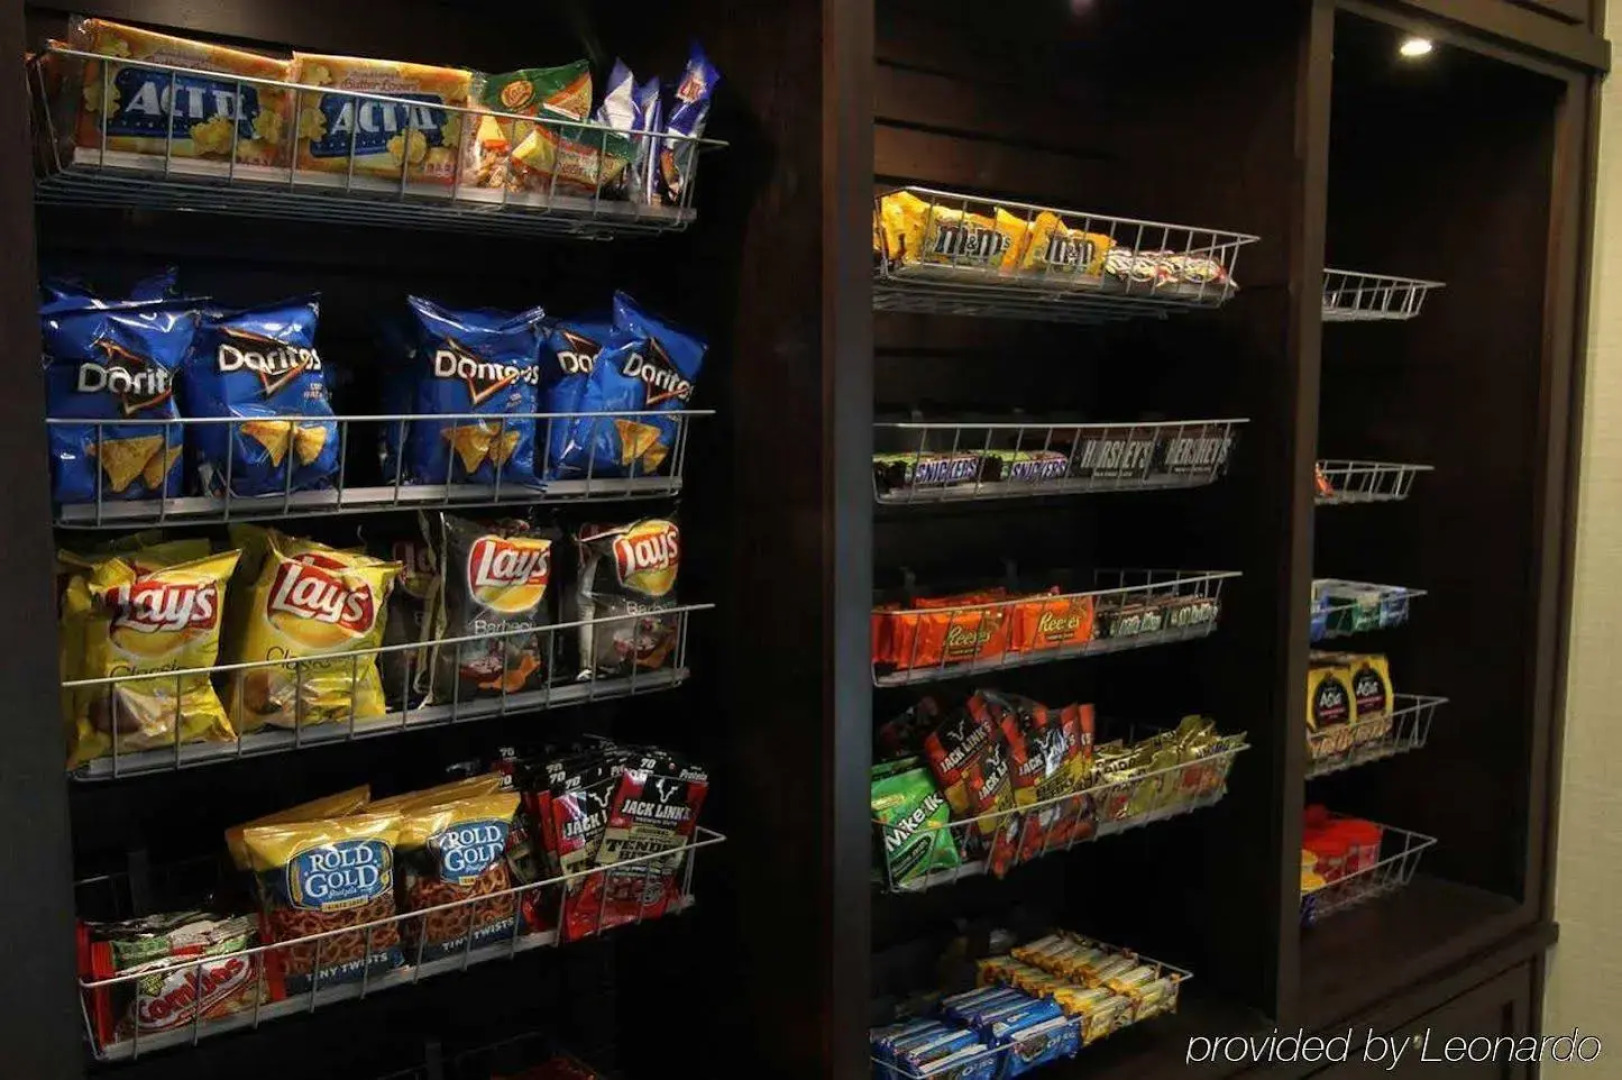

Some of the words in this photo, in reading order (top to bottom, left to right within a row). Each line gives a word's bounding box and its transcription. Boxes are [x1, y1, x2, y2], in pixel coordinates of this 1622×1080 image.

[125, 81, 206, 118] ACT
[331, 100, 398, 134] ACT
[218, 344, 321, 376] Doritos
[434, 350, 540, 385] Doritos
[78, 361, 173, 395] Dorit
[475, 540, 551, 586] Lay's
[623, 529, 678, 571] Lay's
[113, 582, 215, 633] Lay's
[270, 561, 365, 623] Lay's
[1038, 612, 1080, 632] Reee's
[940, 748, 965, 773] JACK
[961, 721, 991, 752] LINK'S
[549, 771, 567, 784] 70
[640, 759, 657, 769] 70
[1018, 754, 1045, 775] JACK
[979, 774, 1000, 800] JACK
[622, 800, 656, 817] JACK
[448, 825, 502, 849] ROLD
[566, 813, 601, 837] JACK
[886, 809, 926, 852] Mike
[309, 845, 374, 873] ROLD
[305, 865, 379, 897] GOLD
[305, 967, 339, 982] TNY
